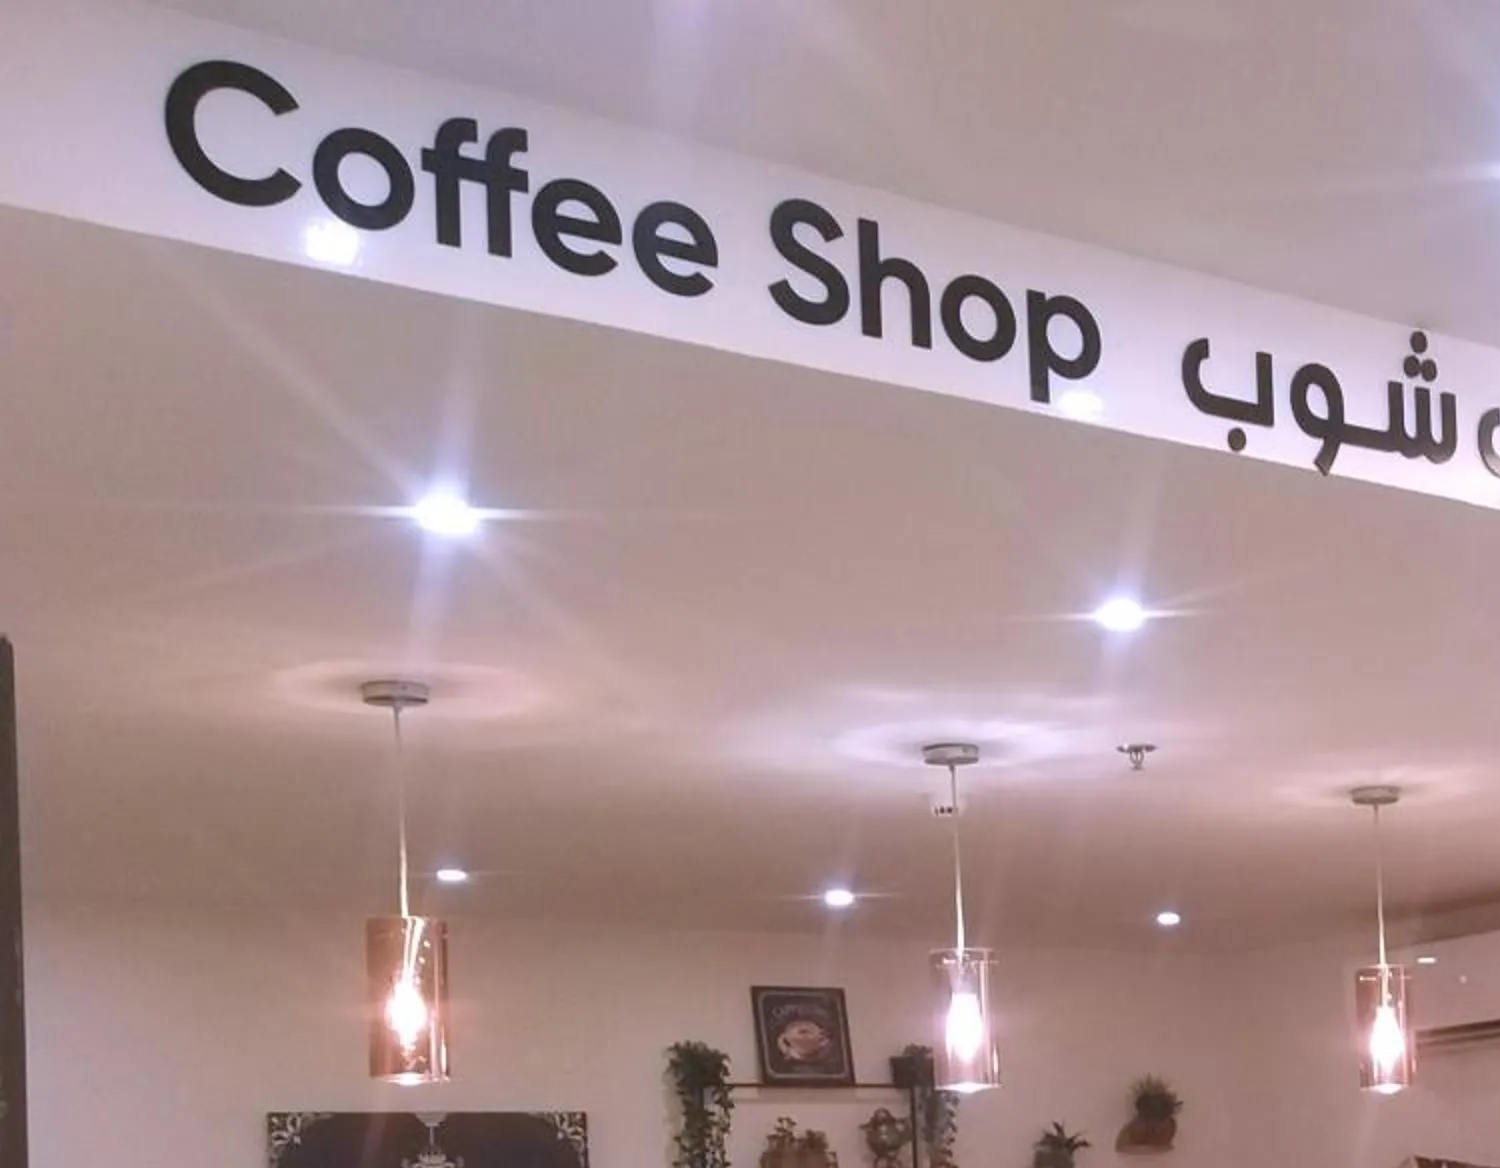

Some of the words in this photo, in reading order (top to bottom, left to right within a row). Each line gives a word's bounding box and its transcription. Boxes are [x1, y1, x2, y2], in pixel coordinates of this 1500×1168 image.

[164, 59, 719, 298] Coffee
[767, 198, 1102, 403] Shop
[1181, 330, 1457, 476] شوب
